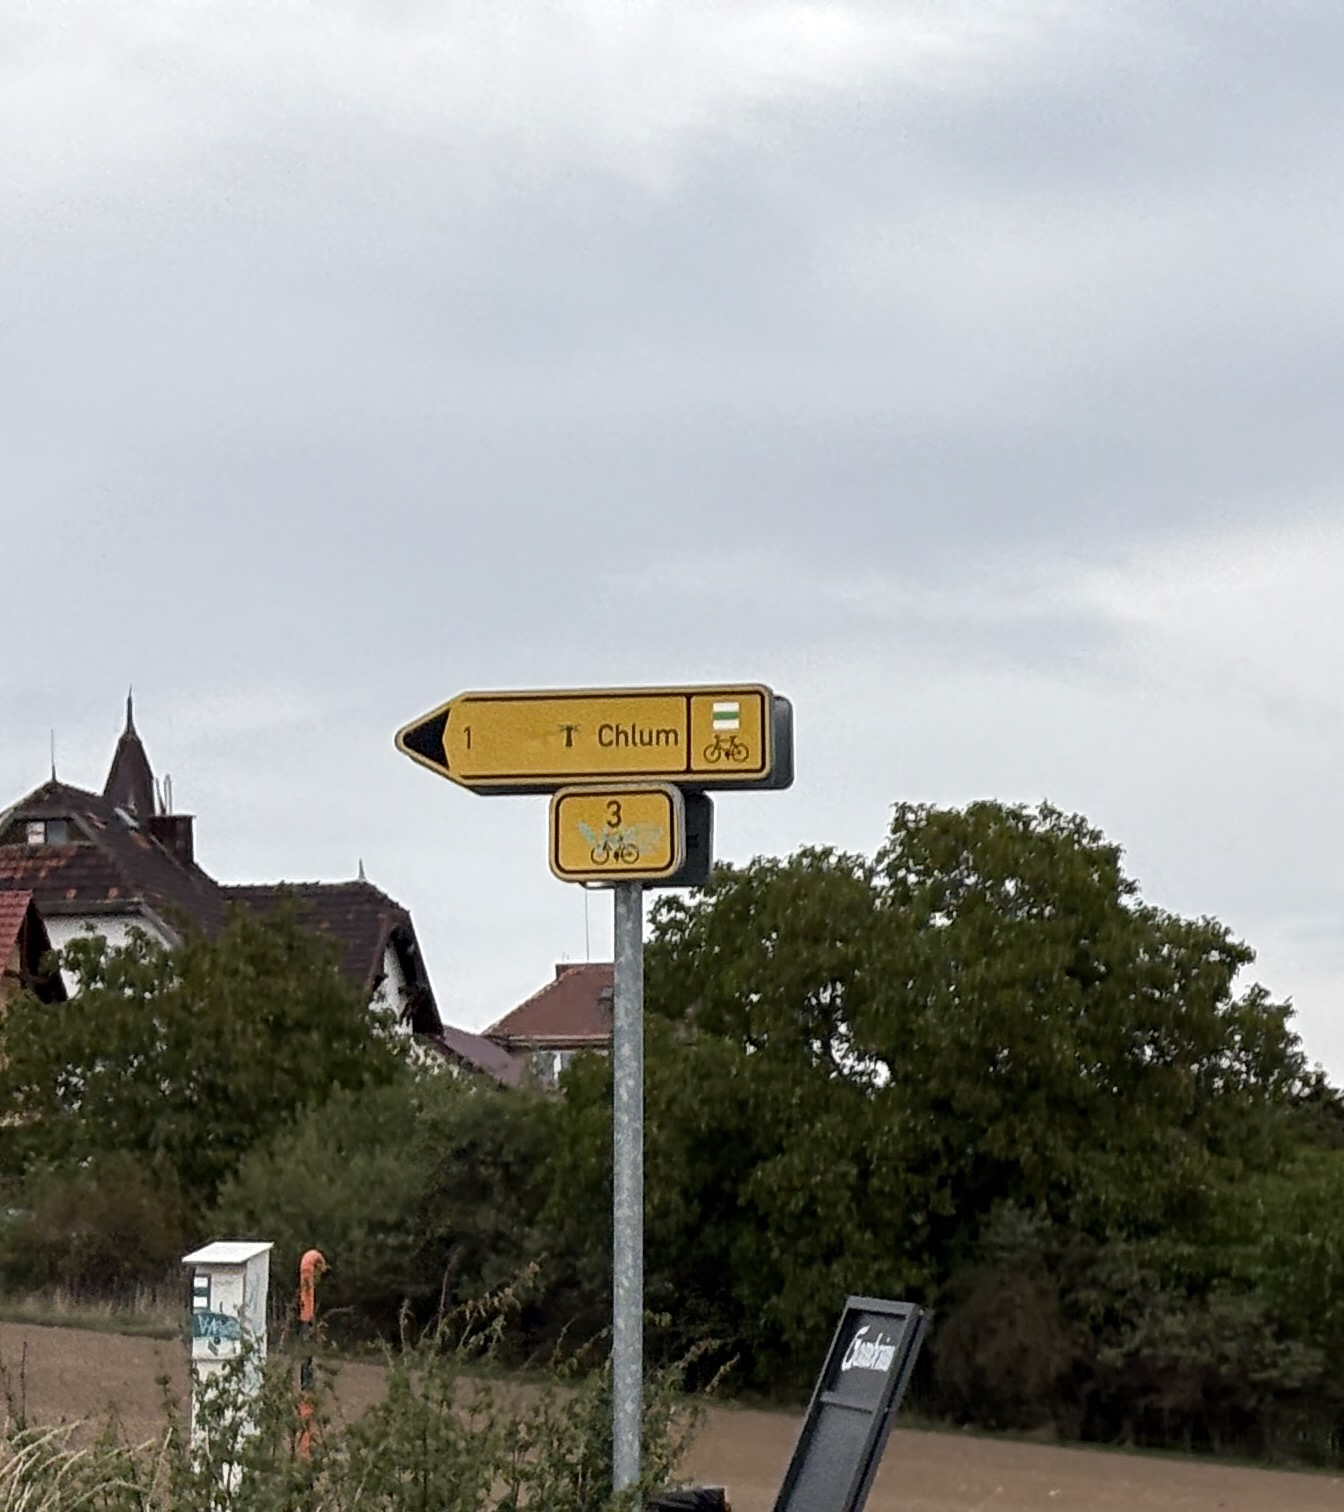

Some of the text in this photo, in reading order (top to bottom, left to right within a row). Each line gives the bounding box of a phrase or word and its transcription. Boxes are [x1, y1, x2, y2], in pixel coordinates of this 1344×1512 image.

[464, 723, 679, 749] 1 Chlum
[606, 801, 622, 828] 3
